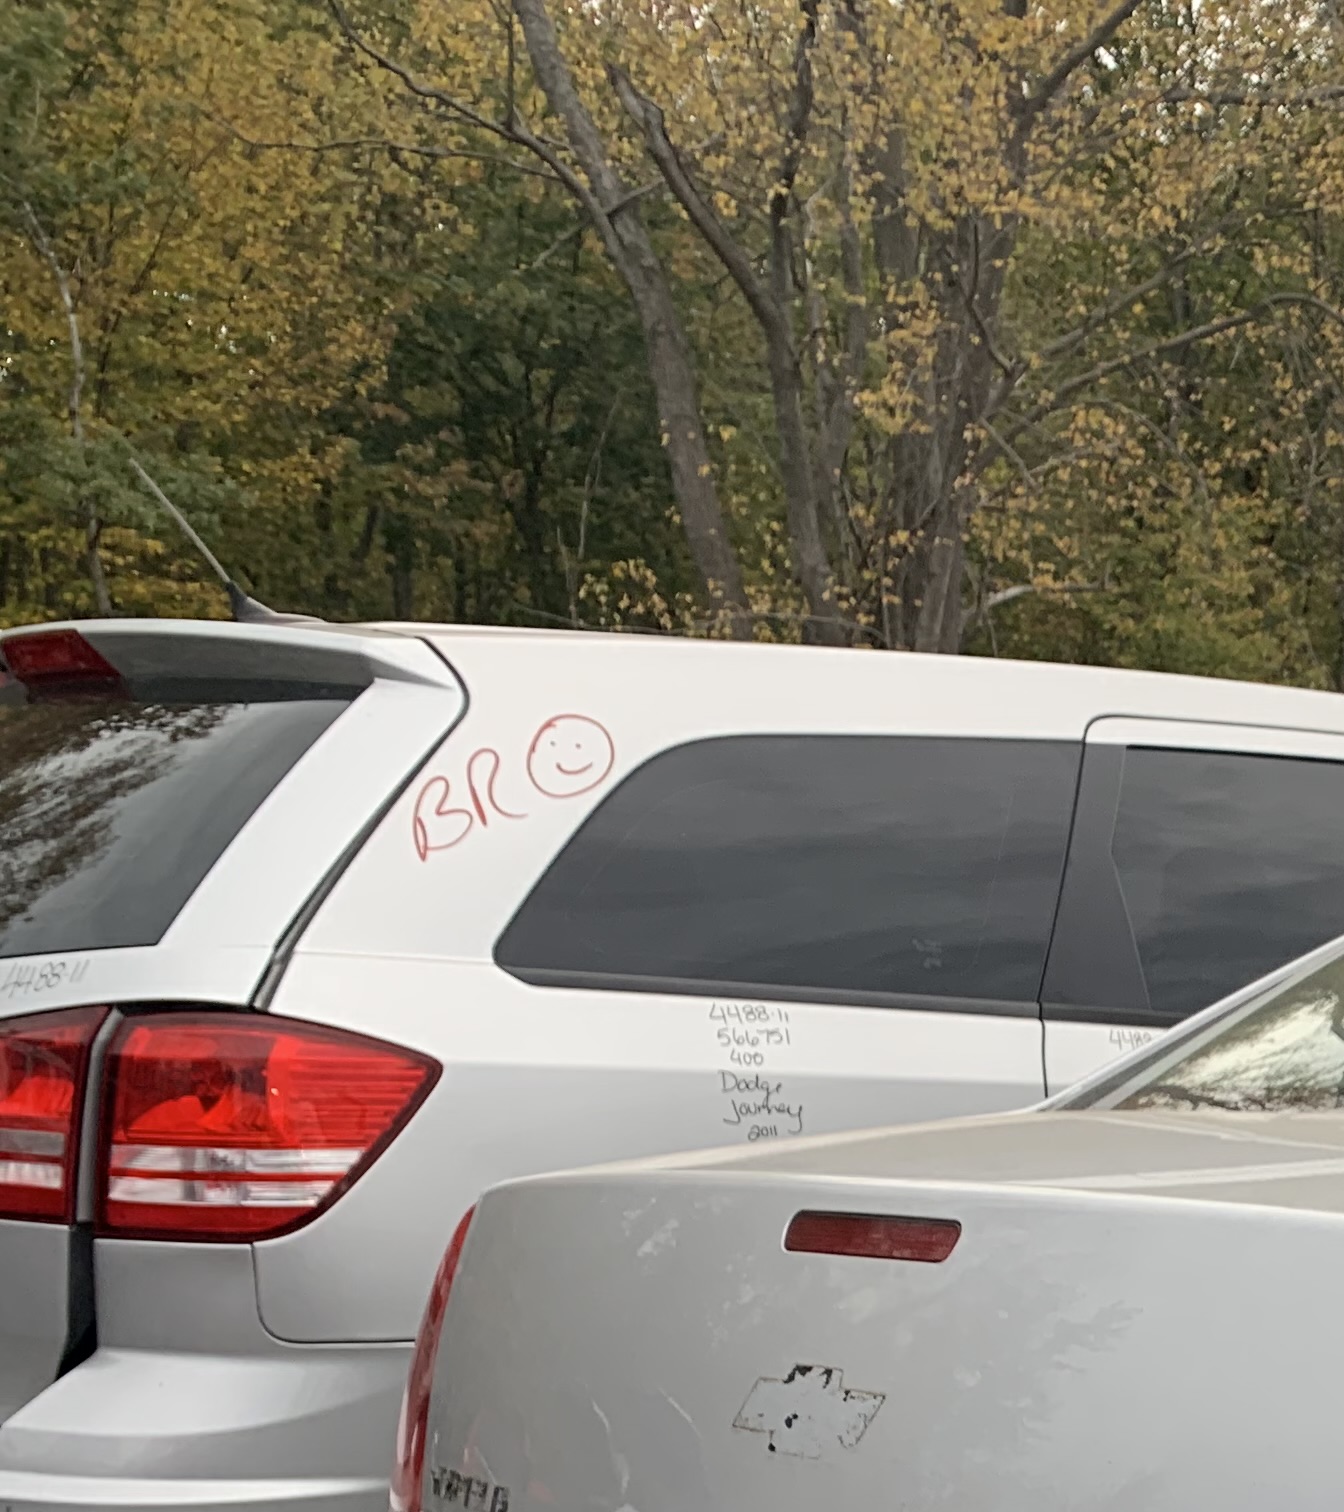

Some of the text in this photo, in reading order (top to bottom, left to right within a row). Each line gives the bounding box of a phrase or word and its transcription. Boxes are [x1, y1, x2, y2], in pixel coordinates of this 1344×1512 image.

[717, 1027, 790, 1047] 566751
[730, 1049, 764, 1066] 400
[717, 1070, 782, 1103] Dodge
[748, 1125, 778, 1141] 2011
